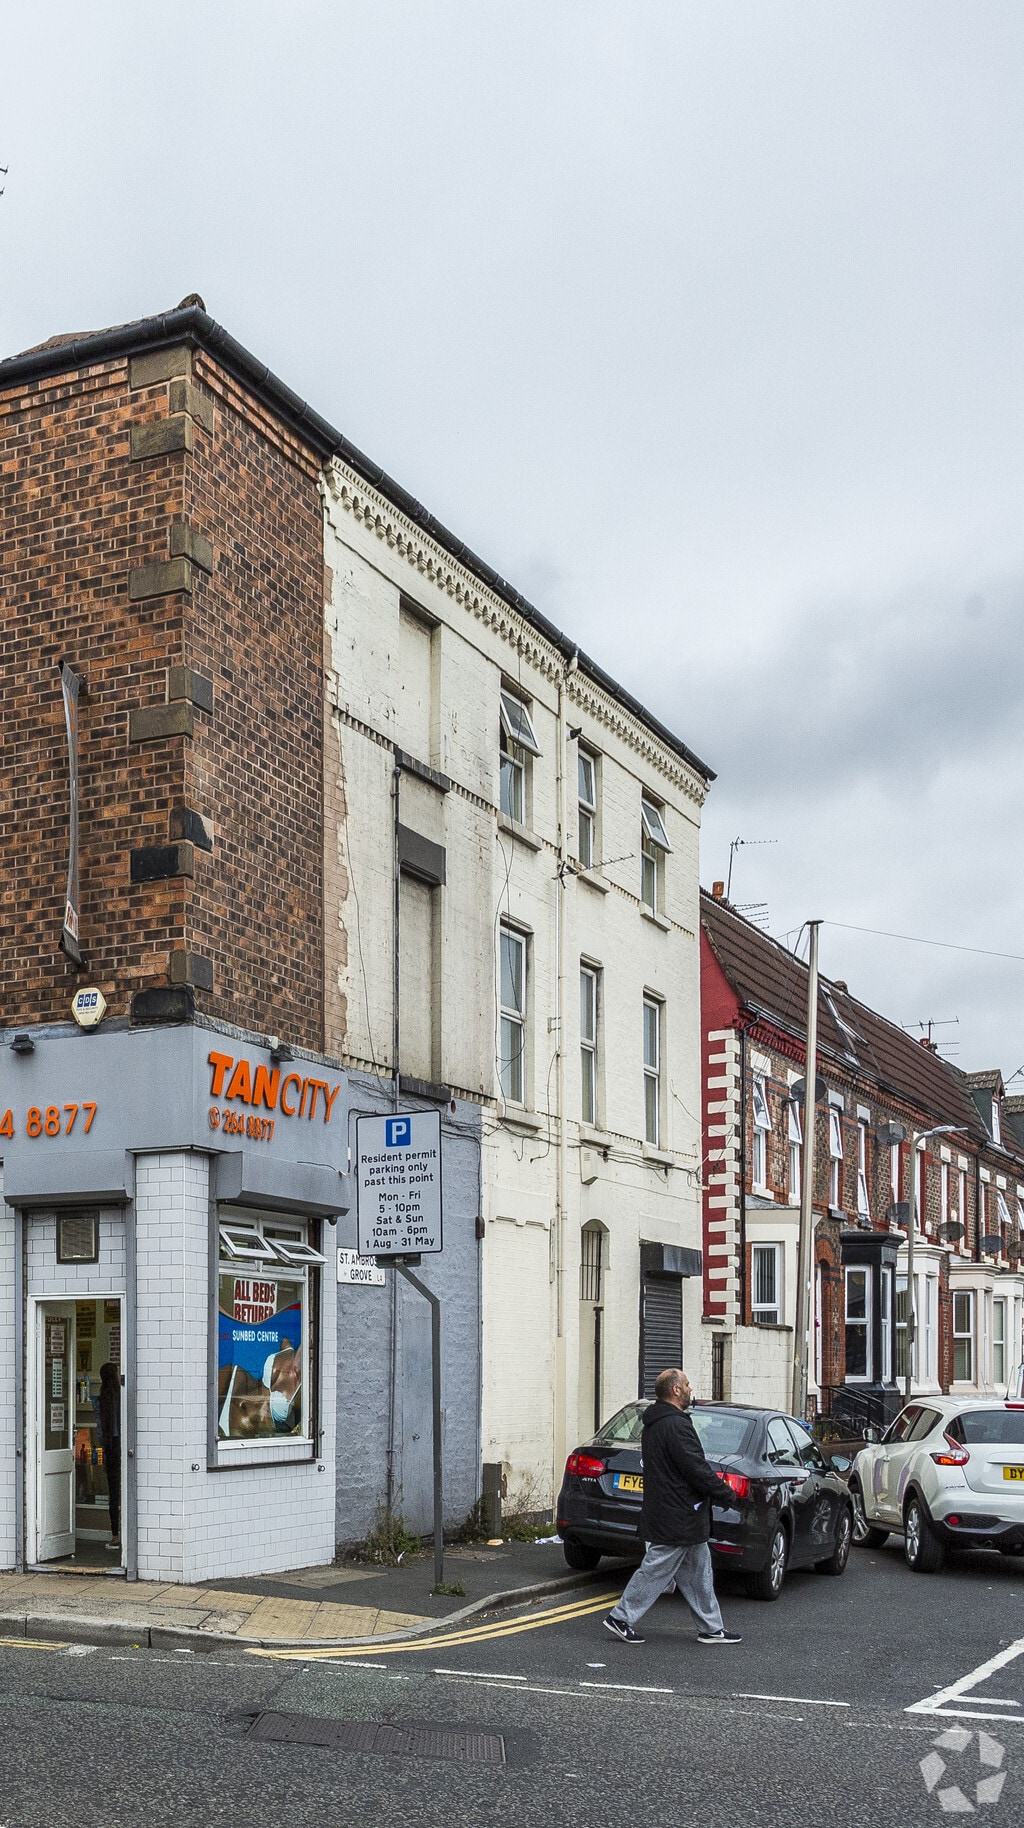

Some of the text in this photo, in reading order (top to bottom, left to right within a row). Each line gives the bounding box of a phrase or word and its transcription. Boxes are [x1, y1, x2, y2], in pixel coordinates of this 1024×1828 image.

[209, 1050, 342, 1123] TANCITY
[26, 1102, 97, 1137] 8877
[222, 1109, 275, 1142] 264 8877
[392, 1121, 407, 1144] P
[361, 1149, 437, 1164] Resident permit
[369, 1162, 428, 1176] parking only
[364, 1173, 433, 1188] past this point
[378, 1192, 399, 1202] Mon
[409, 1190, 421, 1199] Fri
[379, 1204, 385, 1213] 5
[395, 1203, 420, 1213] 10pm
[376, 1214, 424, 1225] Sat & Sun
[372, 1227, 397, 1236] 10am
[407, 1225, 428, 1235] 6pm
[366, 1240, 369, 1248] 1
[373, 1239, 391, 1249] Aug
[401, 1237, 411, 1246] 31
[415, 1236, 435, 1246] May
[340, 1252, 350, 1265] ST.
[350, 1269, 372, 1281] GROVE
[234, 1280, 276, 1304] ALL BEDS
[234, 1303, 274, 1322] RETUBED
[232, 1330, 256, 1342] SUNBED
[257, 1331, 279, 1342] CENTRE
